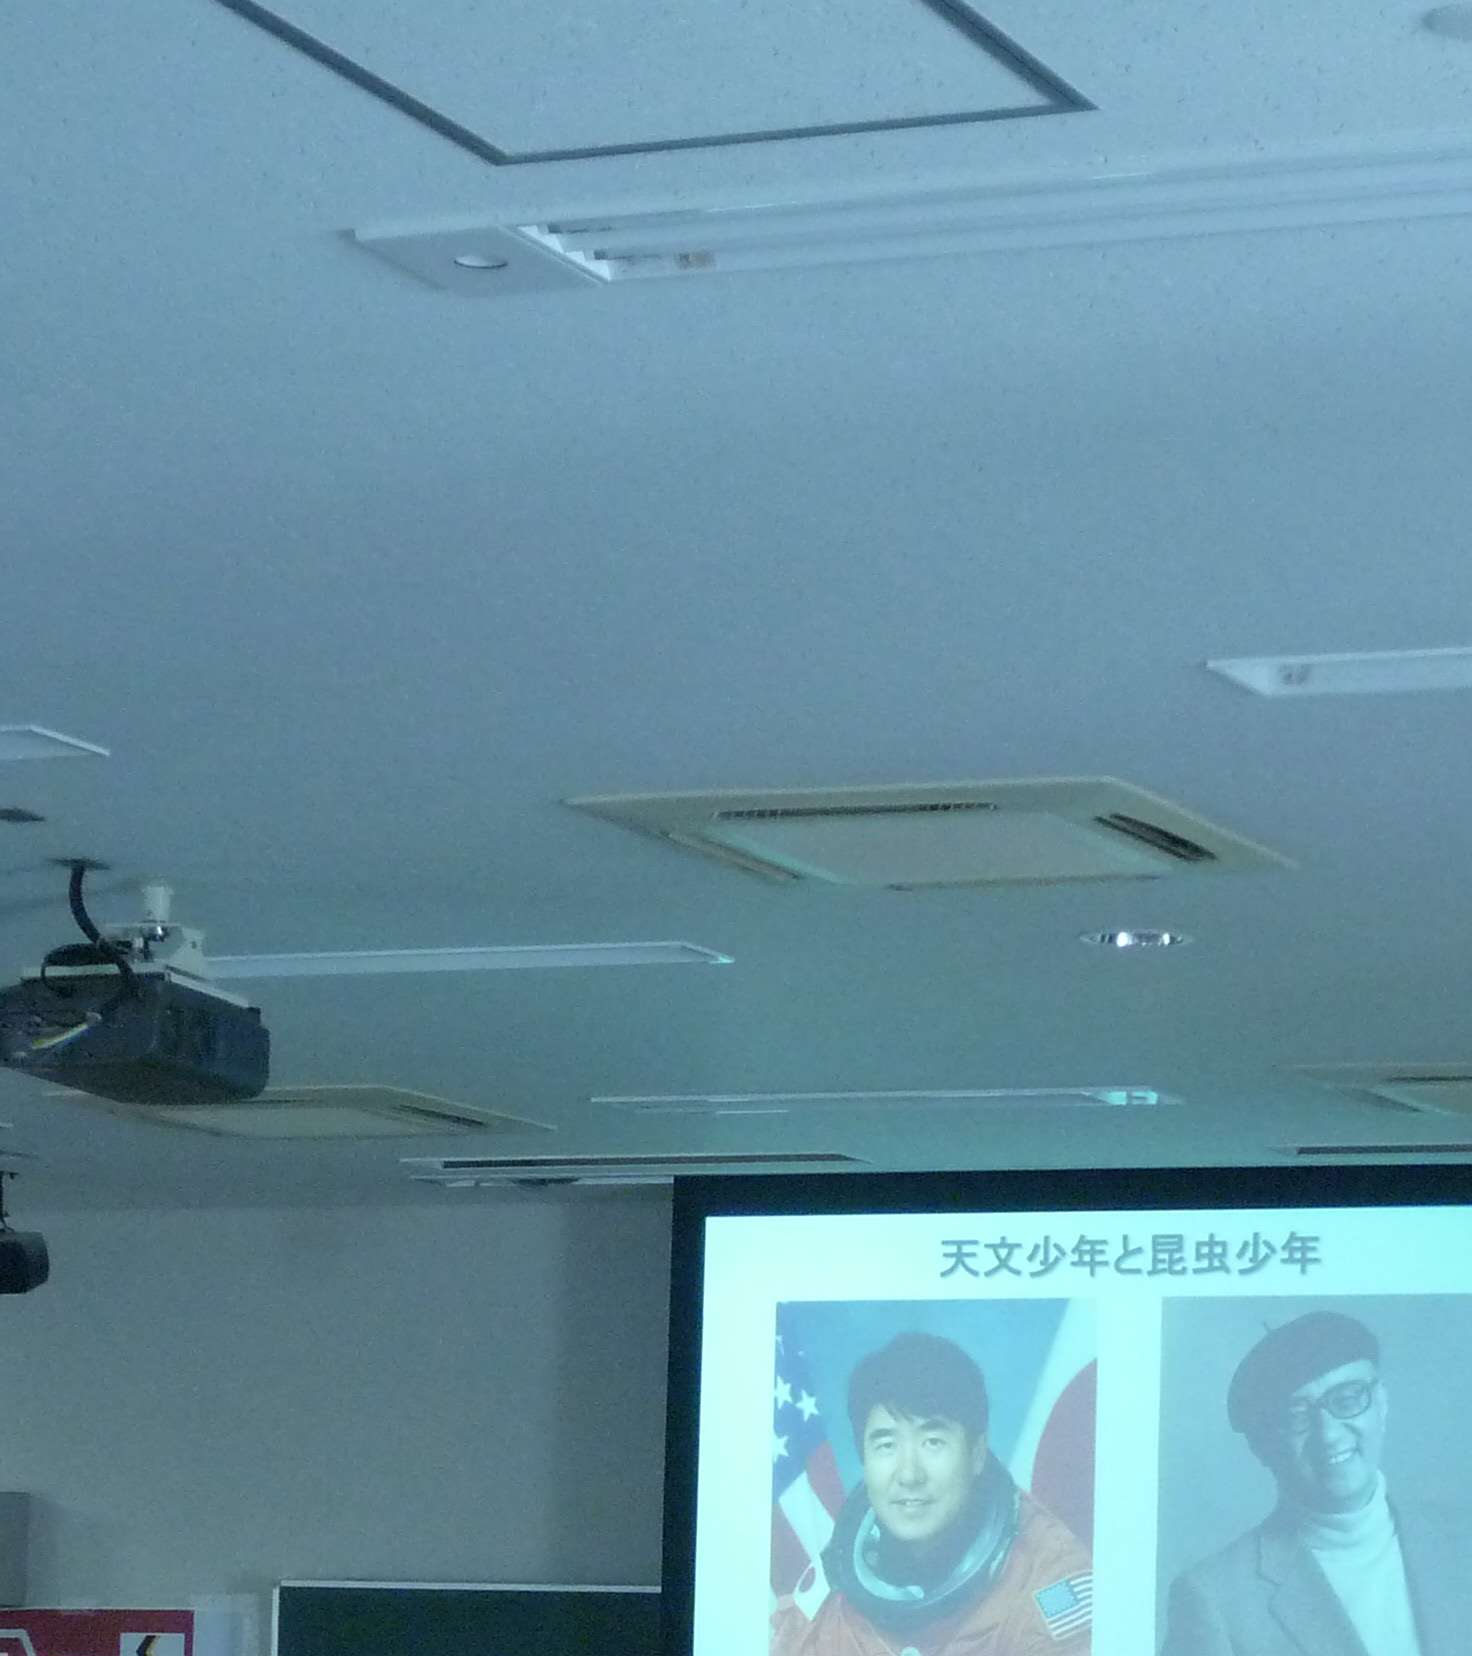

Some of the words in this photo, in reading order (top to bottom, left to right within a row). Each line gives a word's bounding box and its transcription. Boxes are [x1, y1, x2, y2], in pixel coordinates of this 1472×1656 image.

[939, 1231, 1322, 1278] 天文少年と昆虫少年
